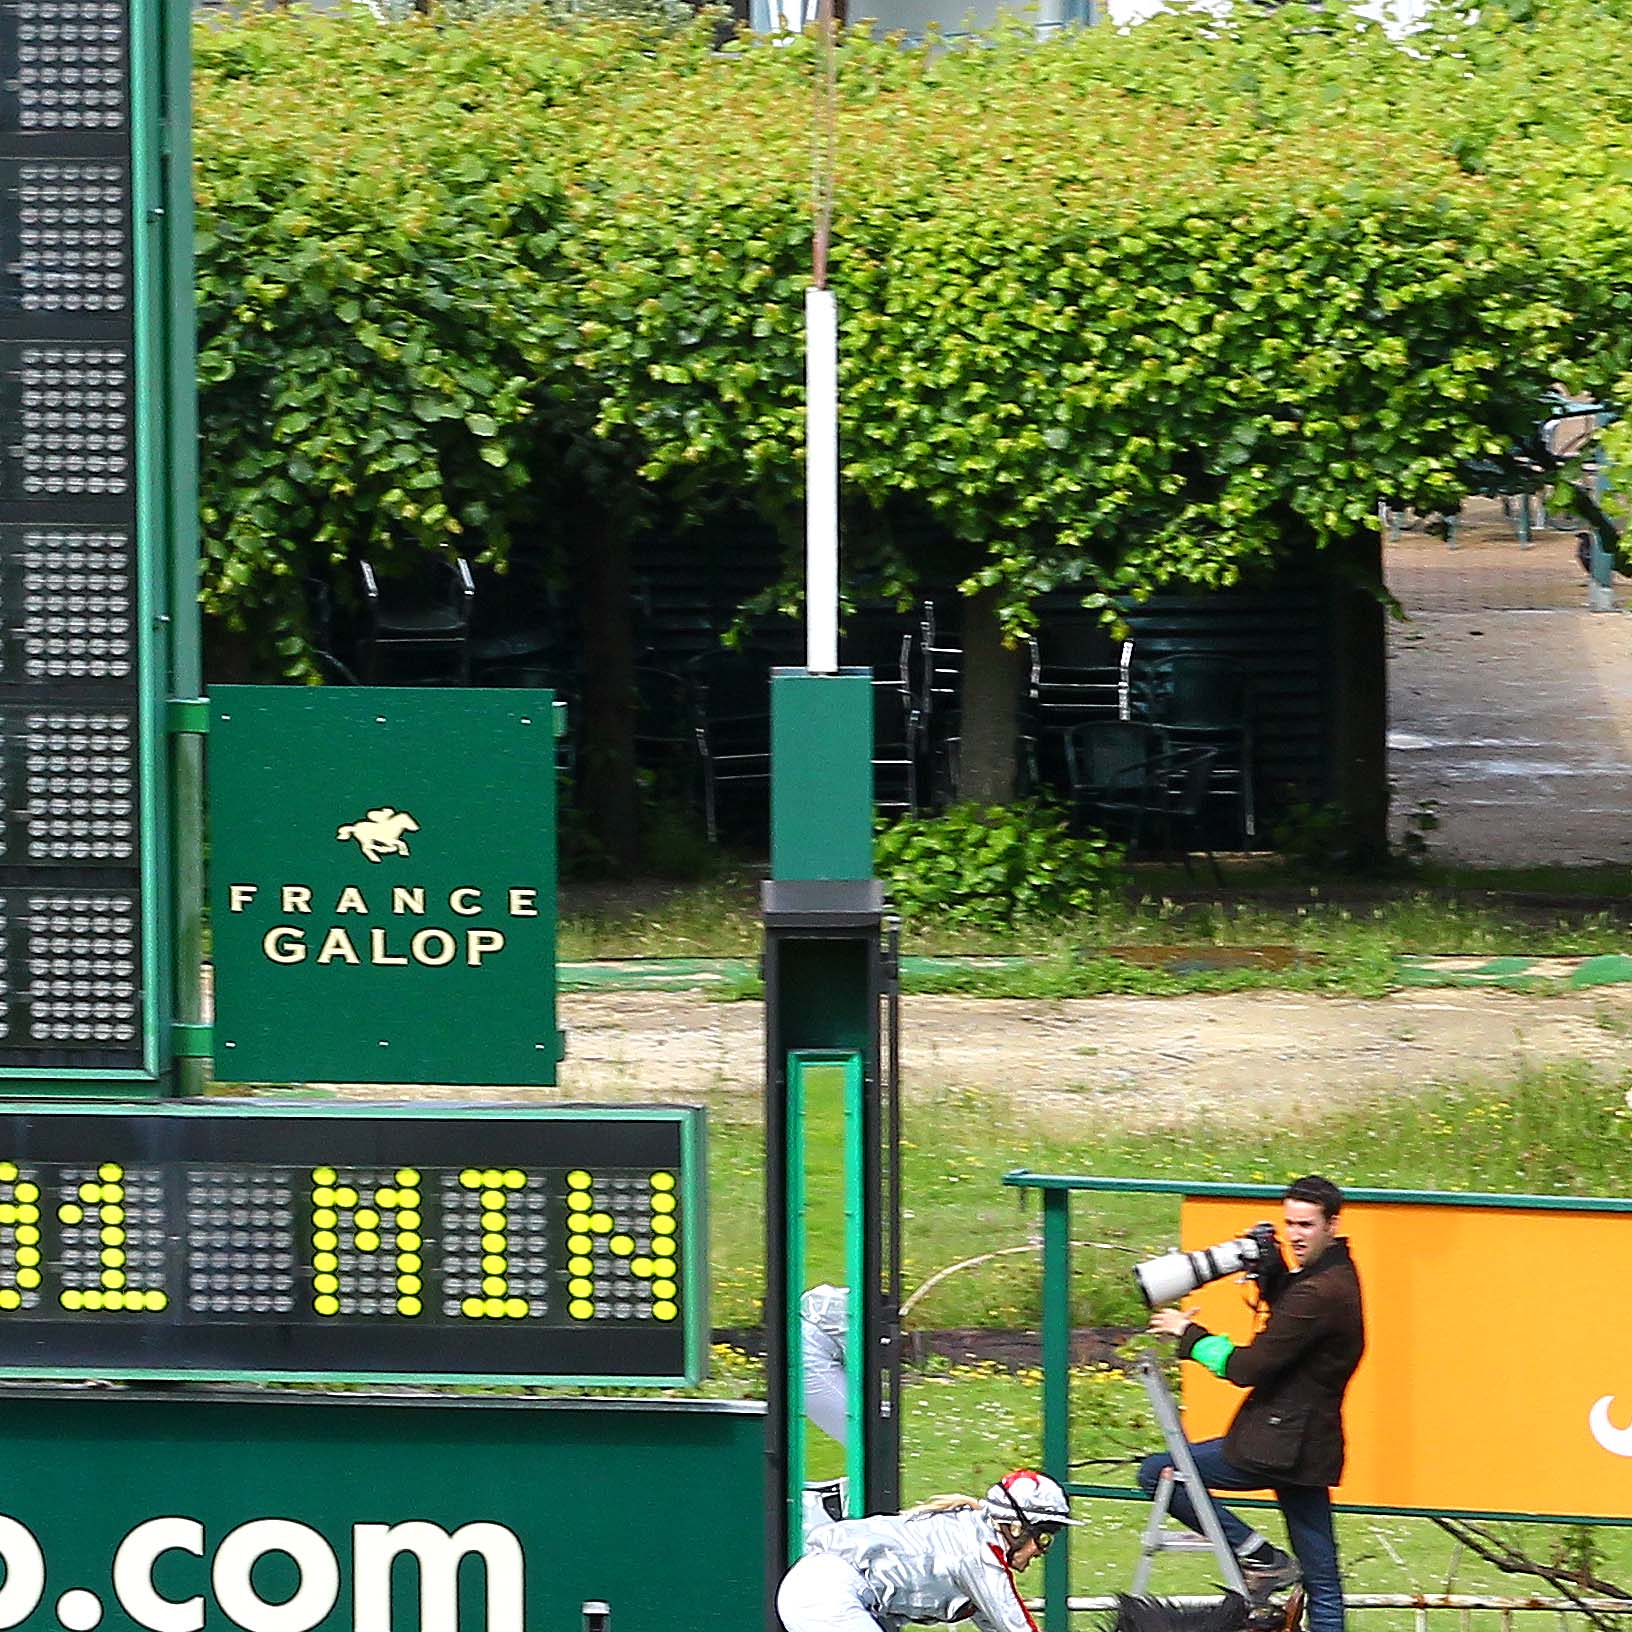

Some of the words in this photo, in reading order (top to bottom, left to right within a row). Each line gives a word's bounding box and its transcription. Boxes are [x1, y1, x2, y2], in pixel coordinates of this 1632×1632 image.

[229, 885, 538, 916] FRANCE
[262, 926, 506, 966] GALOP
[311, 1166, 679, 1320] MIN
